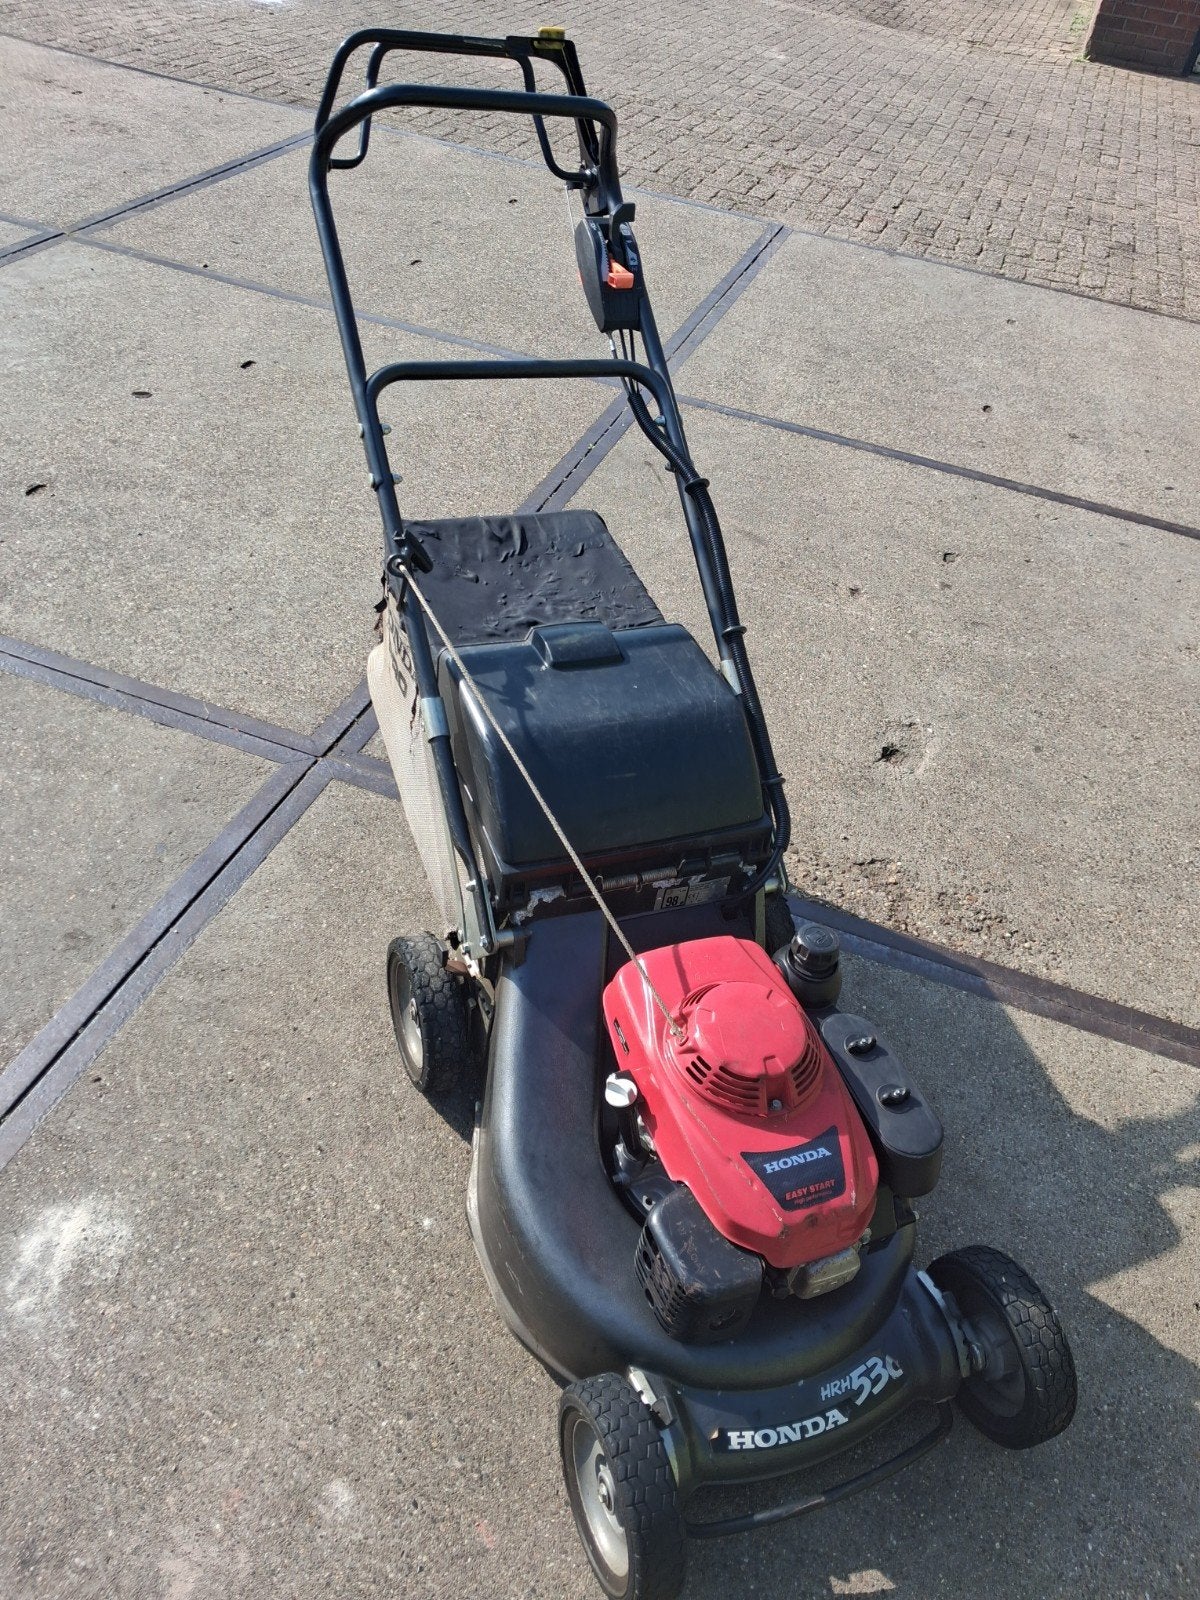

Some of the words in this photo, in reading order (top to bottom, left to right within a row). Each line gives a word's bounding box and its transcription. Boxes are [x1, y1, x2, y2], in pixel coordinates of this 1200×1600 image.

[665, 896, 679, 907] 98
[763, 1147, 832, 1174] HONDA
[785, 1187, 808, 1201] EASY
[809, 1179, 836, 1193] START
[727, 1408, 849, 1450] HONDA
